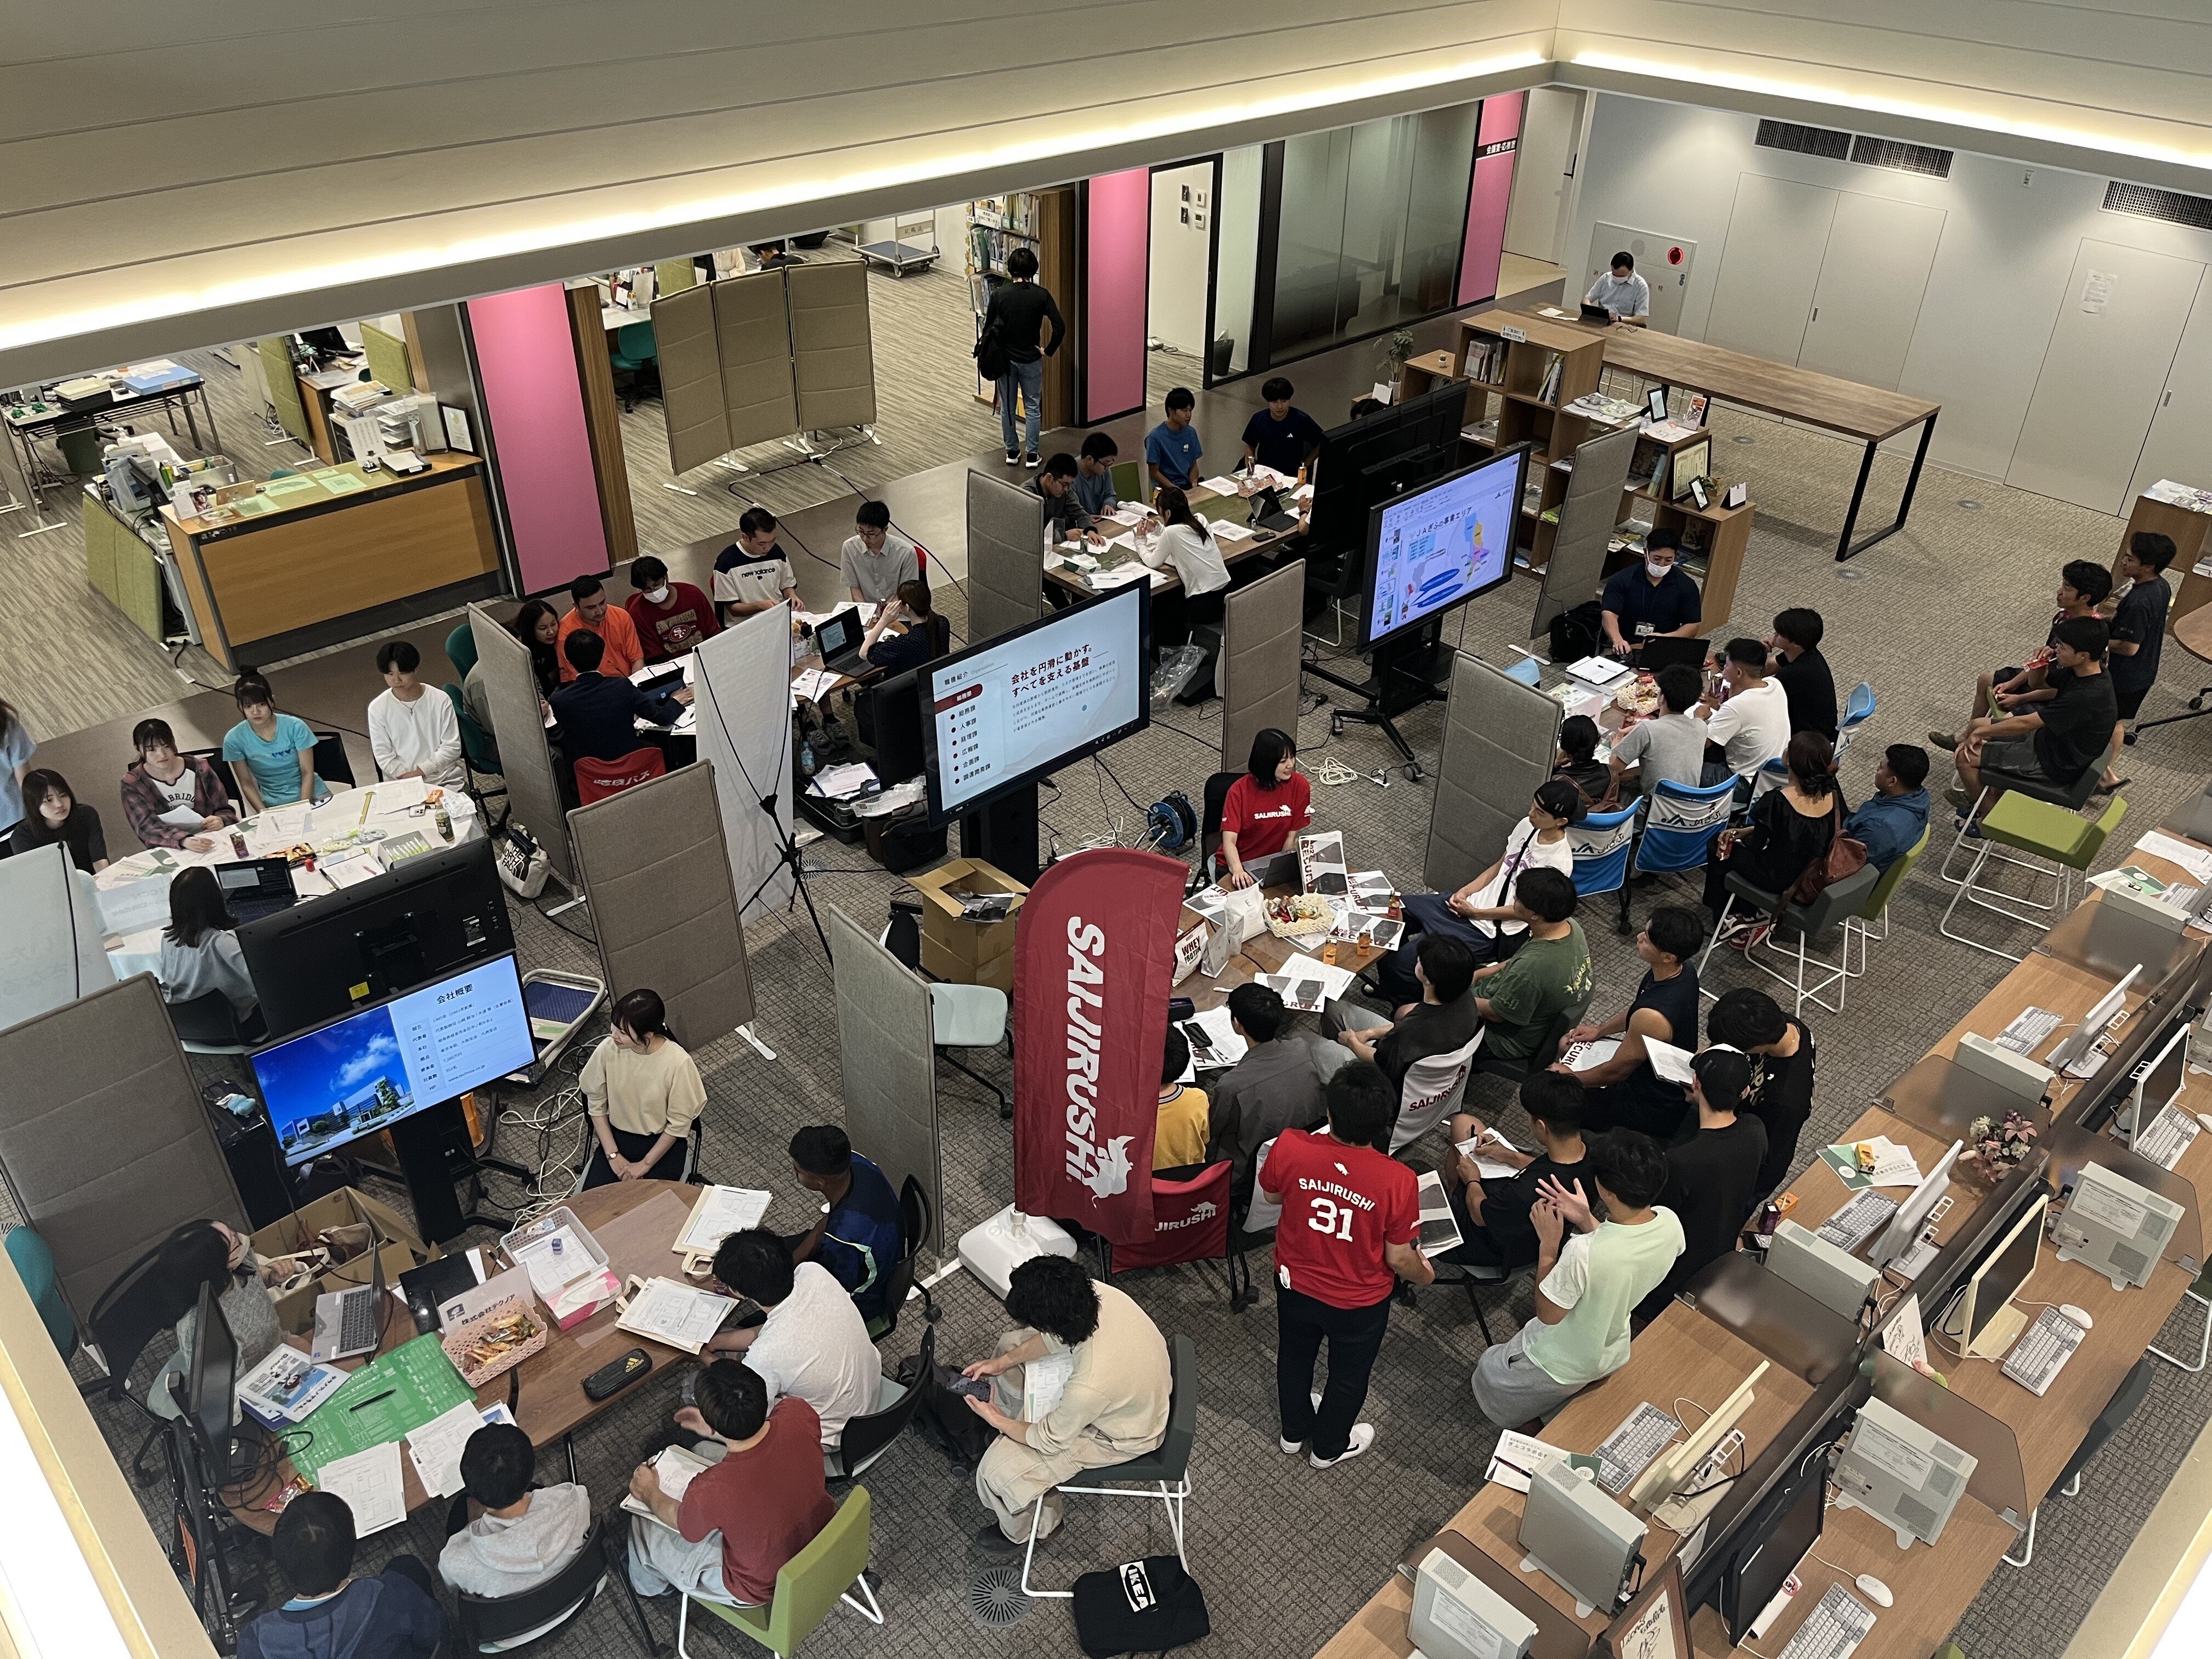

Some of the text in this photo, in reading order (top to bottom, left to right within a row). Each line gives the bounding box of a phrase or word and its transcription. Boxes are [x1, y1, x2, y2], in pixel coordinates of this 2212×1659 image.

[1011, 641, 1092, 686] 会社を円滑に動かす。
[167, 793, 195, 802] BRID
[1254, 811, 1292, 820] SAIJIRUSHI
[1181, 936, 1200, 956] WHEY
[436, 982, 474, 1005] 会社概要
[1066, 916, 1105, 1182] SAIJIRUSHI
[1299, 1178, 1375, 1211] SAIJIRUSHI
[1154, 1209, 1216, 1232] JIRUSHI
[1308, 1197, 1353, 1243] 31
[1127, 1568, 1149, 1610] IKEA
